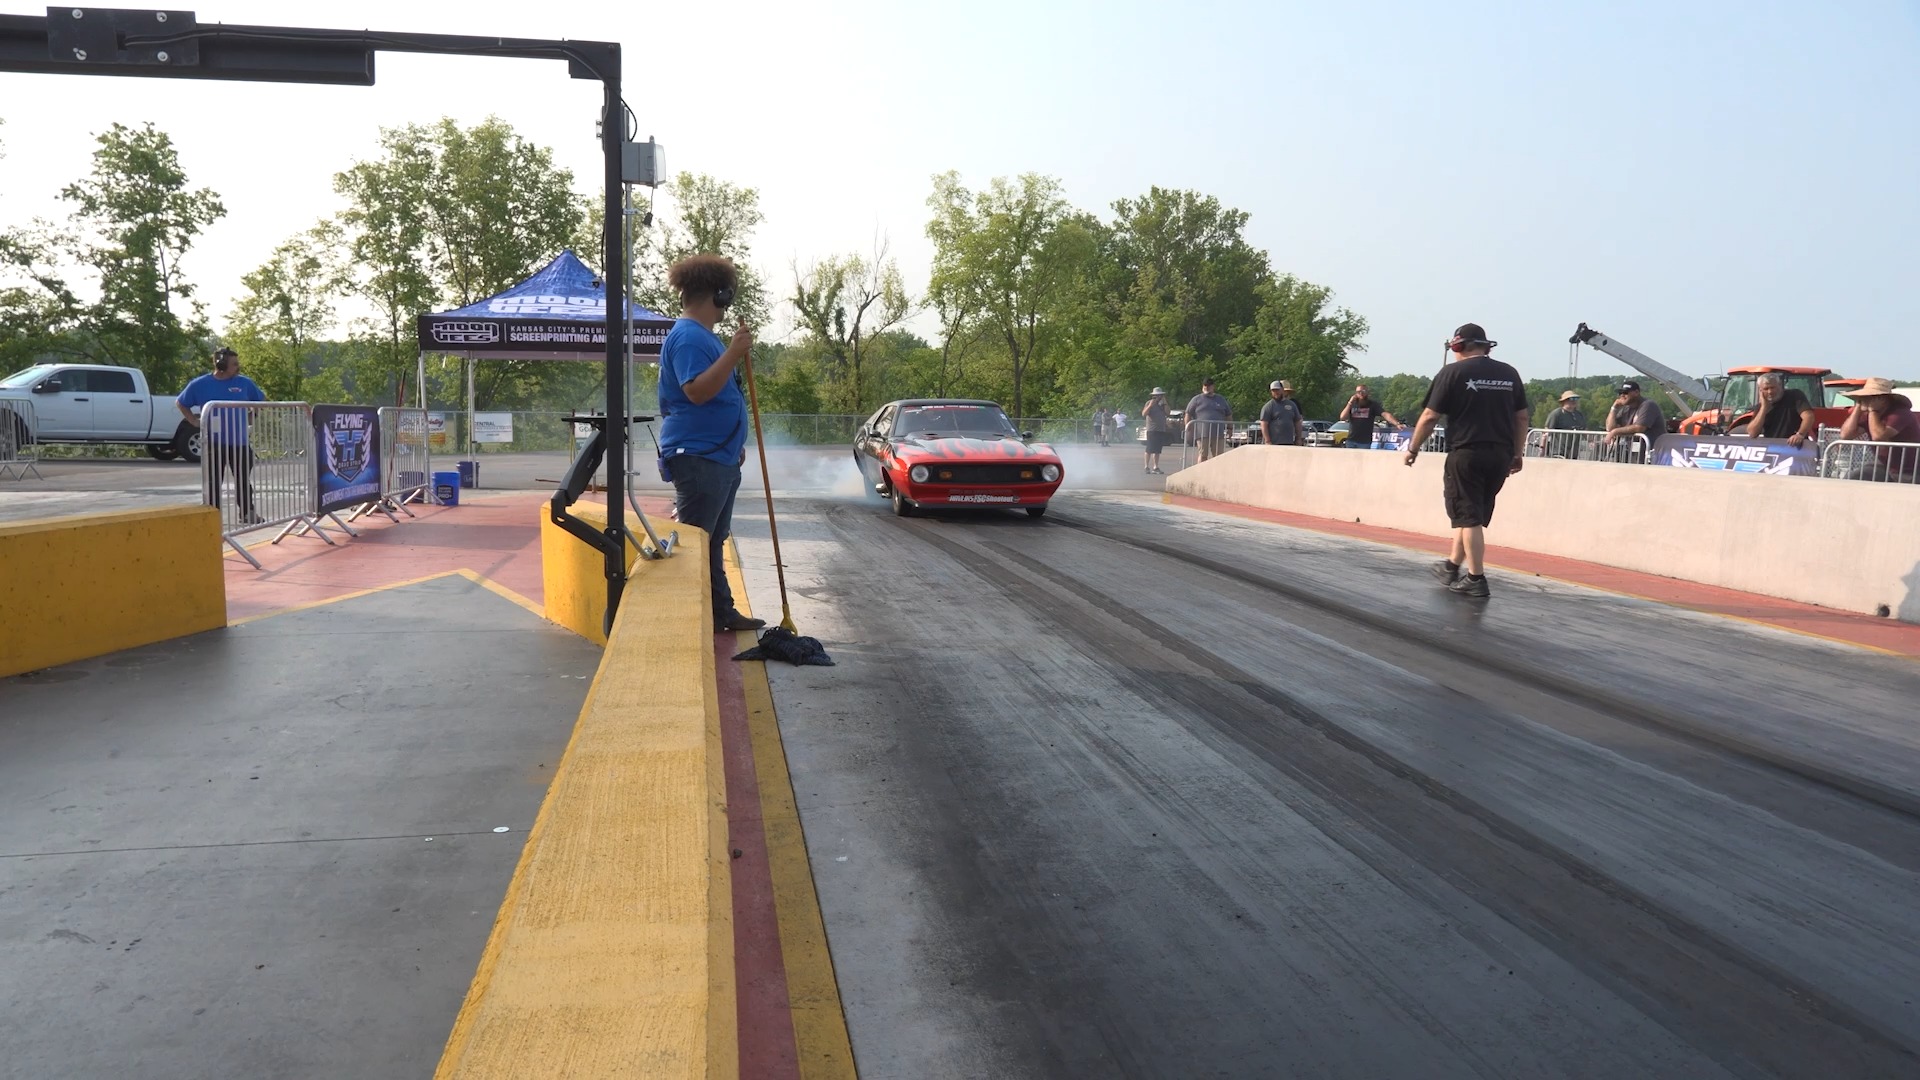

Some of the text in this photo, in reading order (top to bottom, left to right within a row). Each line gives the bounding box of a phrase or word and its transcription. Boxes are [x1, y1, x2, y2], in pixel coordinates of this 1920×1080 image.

[510, 332, 590, 343] SCREENPRINTING
[592, 334, 607, 343] AN
[334, 413, 364, 429] FLYING
[1372, 432, 1399, 443] LYING
[1694, 443, 1767, 462] FLYING
